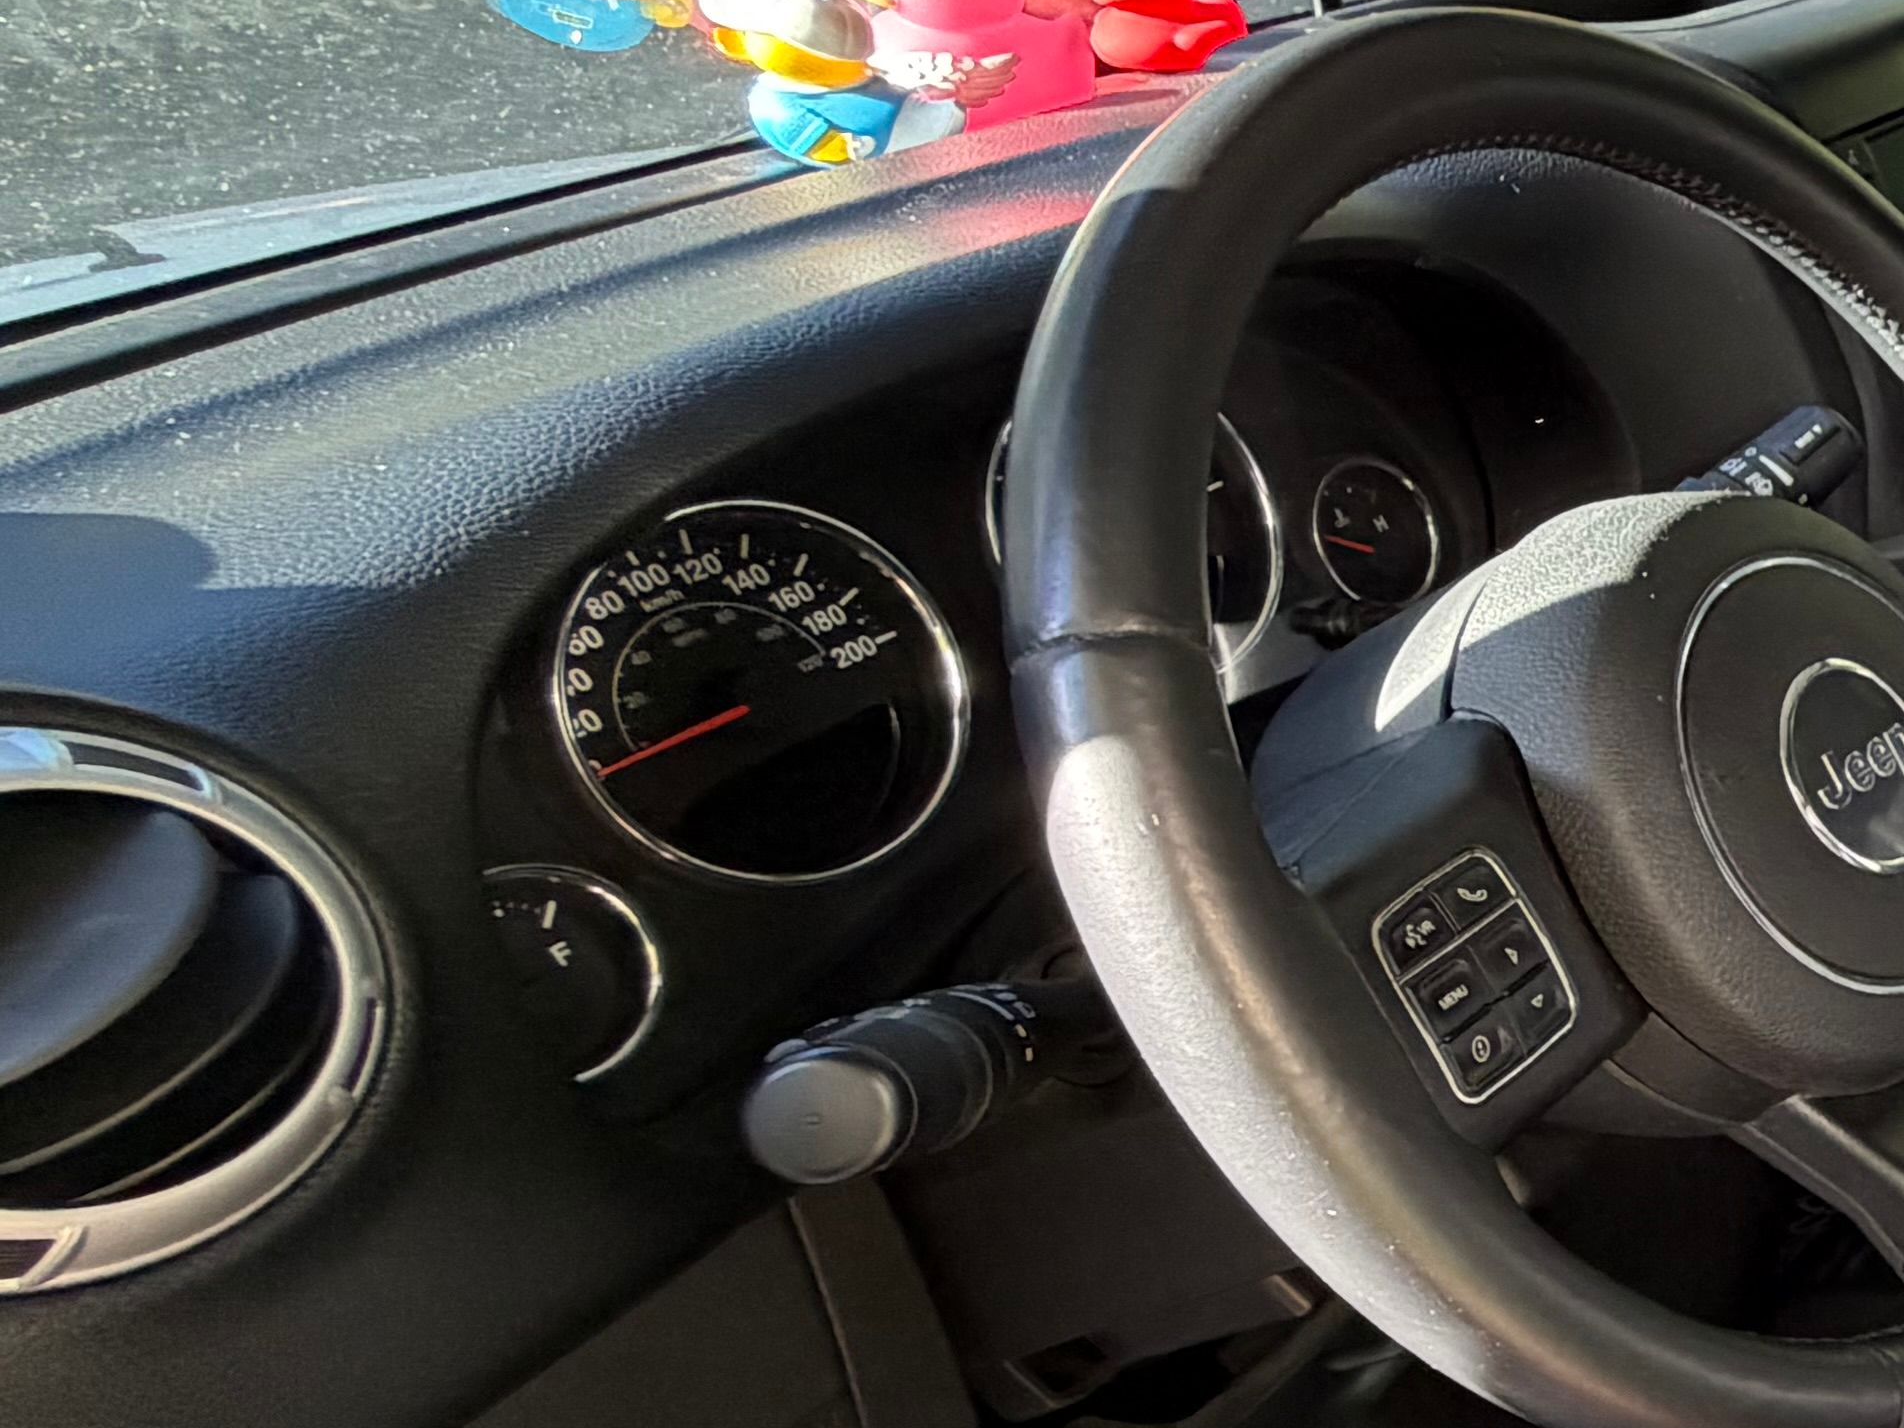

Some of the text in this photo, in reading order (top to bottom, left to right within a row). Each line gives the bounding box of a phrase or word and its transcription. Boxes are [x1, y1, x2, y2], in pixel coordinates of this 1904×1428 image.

[617, 563, 671, 597] 100
[673, 558, 724, 587] 120
[722, 564, 771, 597] 140
[585, 592, 625, 621] 80
[640, 590, 685, 613] km/h
[768, 582, 815, 612] 160
[803, 603, 847, 636] 180
[831, 635, 878, 670] 200
[548, 941, 573, 967] F
[1437, 983, 1469, 1011] MENU
